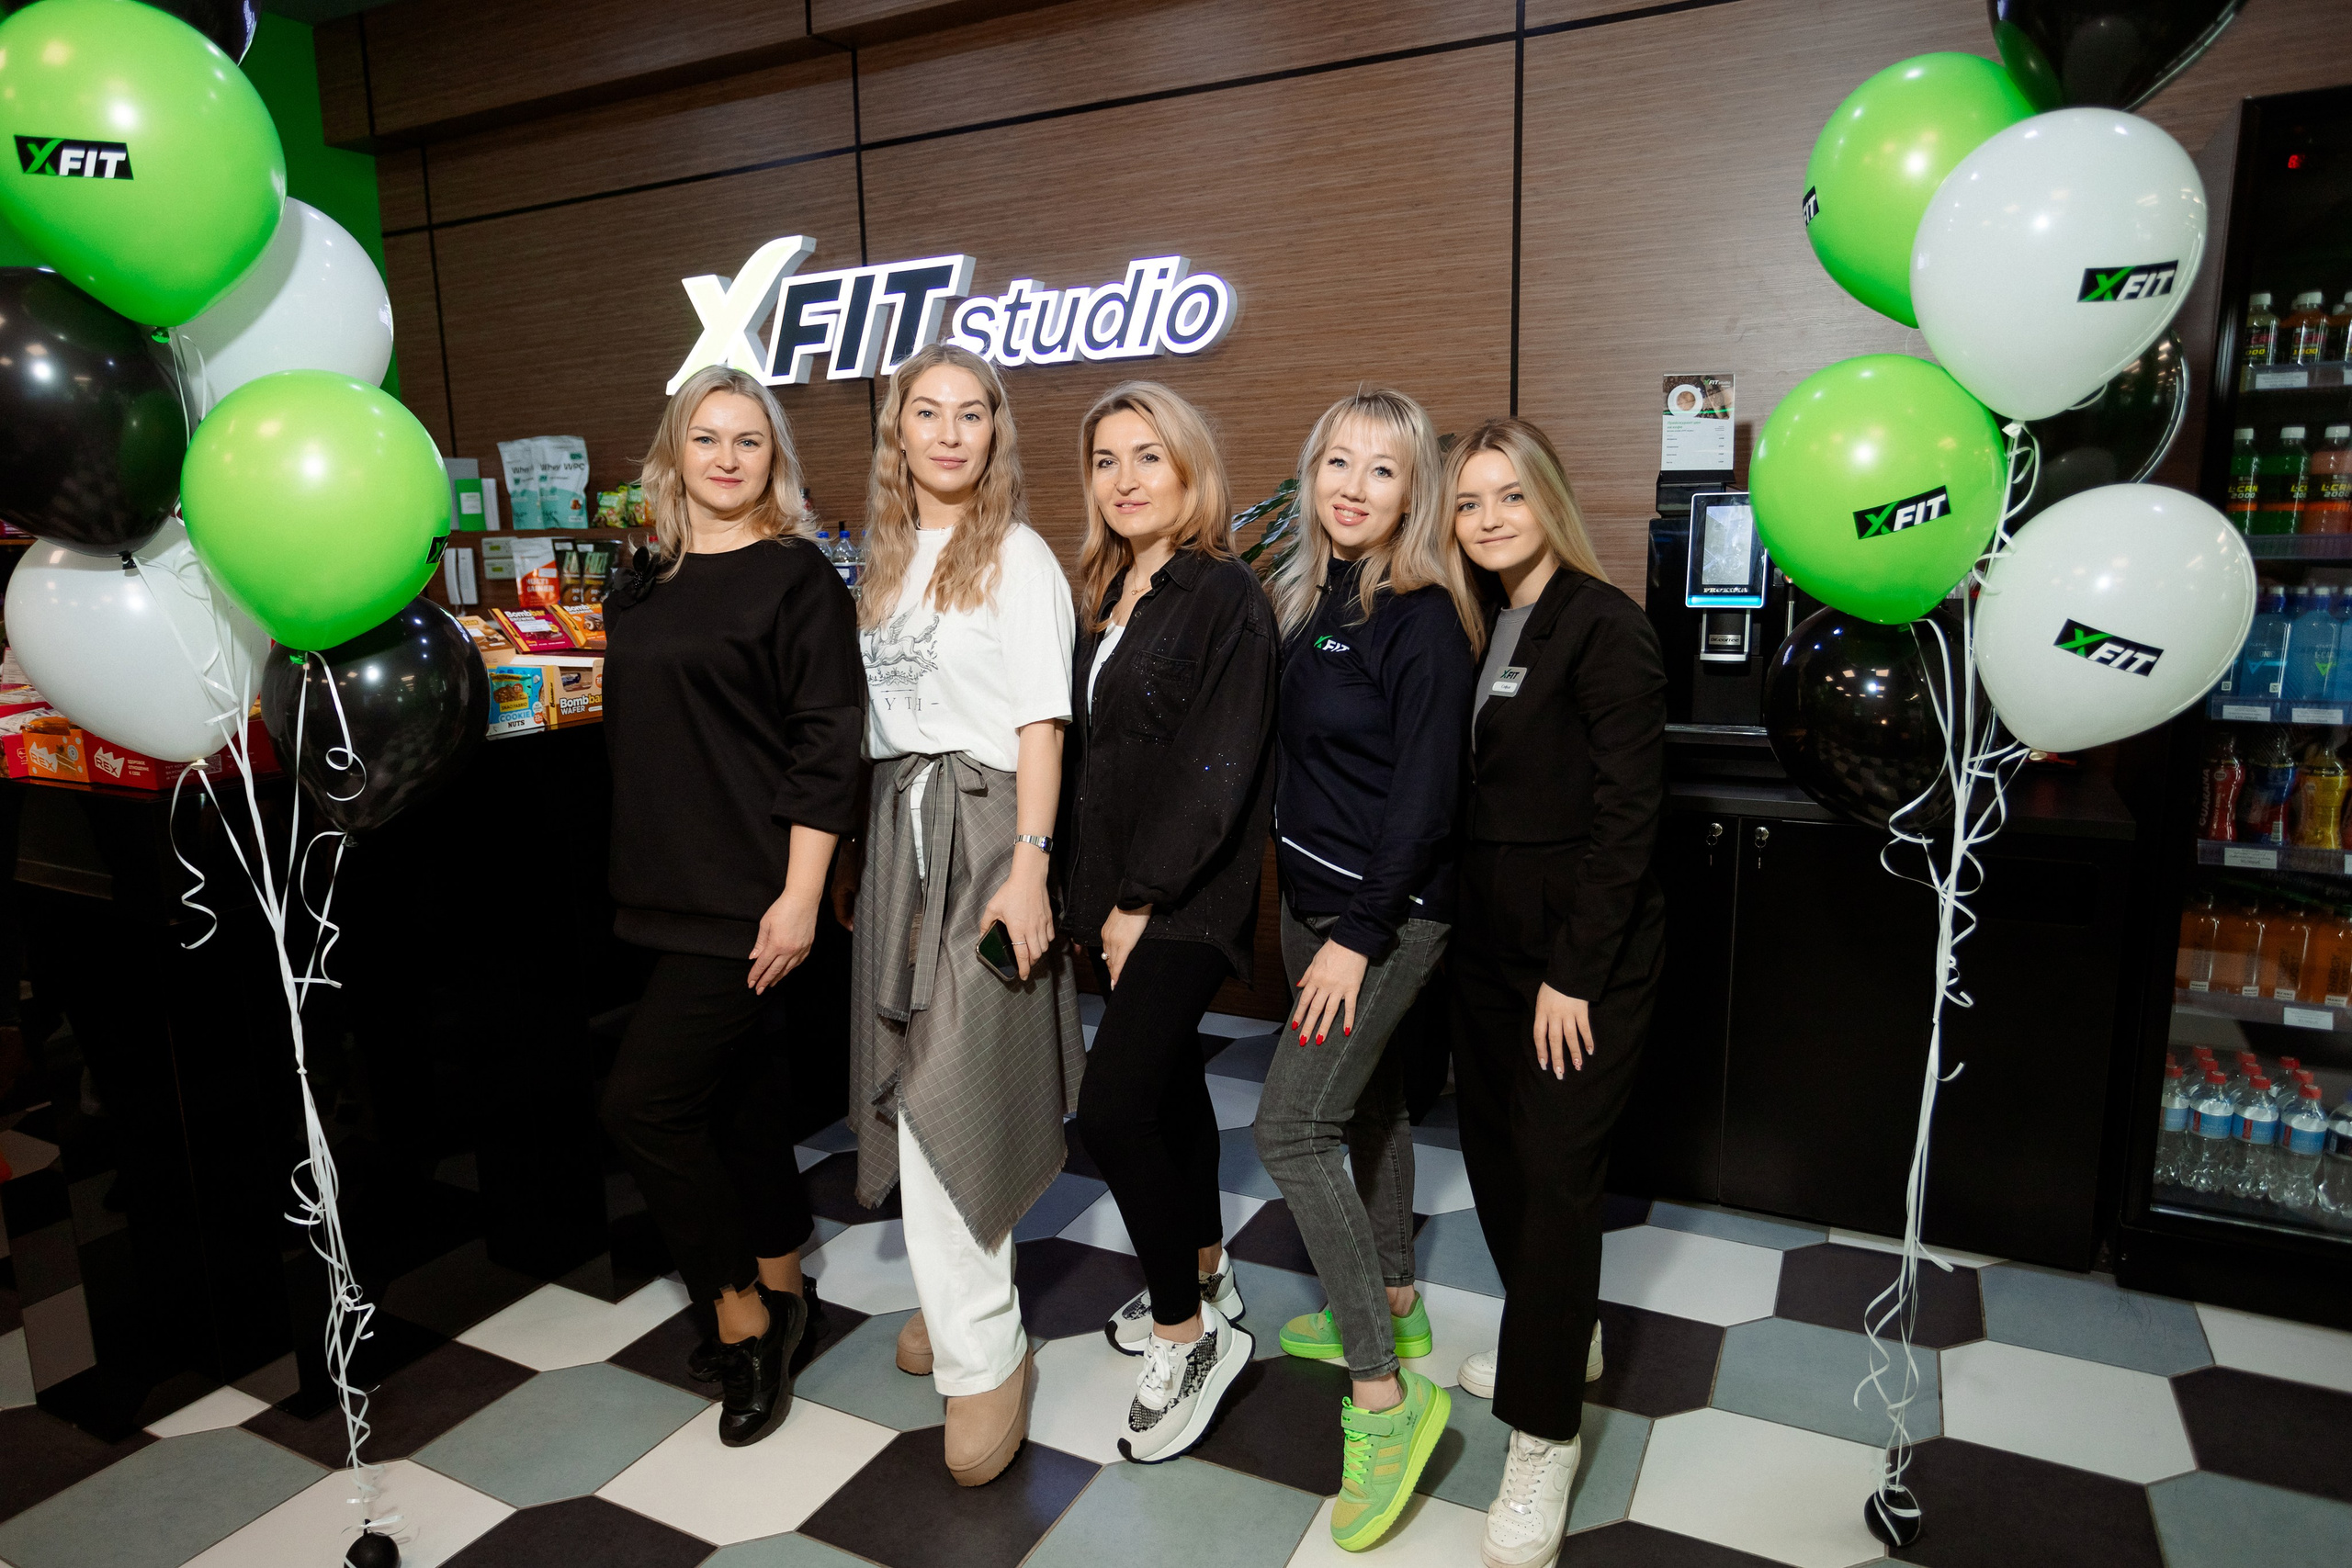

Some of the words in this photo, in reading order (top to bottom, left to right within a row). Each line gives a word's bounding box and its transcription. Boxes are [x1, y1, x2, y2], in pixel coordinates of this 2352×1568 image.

[26, 139, 127, 178] XFIT
[1803, 194, 1816, 223] FIT
[2080, 265, 2176, 301] XFIT
[667, 235, 967, 395] XFIT
[952, 254, 1233, 367] studio
[1860, 494, 1947, 538] XFIT
[2056, 628, 2157, 673] XFIT
[1500, 668, 1520, 680] XFIT
[499, 710, 532, 722] COOKIE
[561, 705, 585, 716] WAFER
[30, 751, 54, 770] REX
[95, 755, 119, 776] REX
